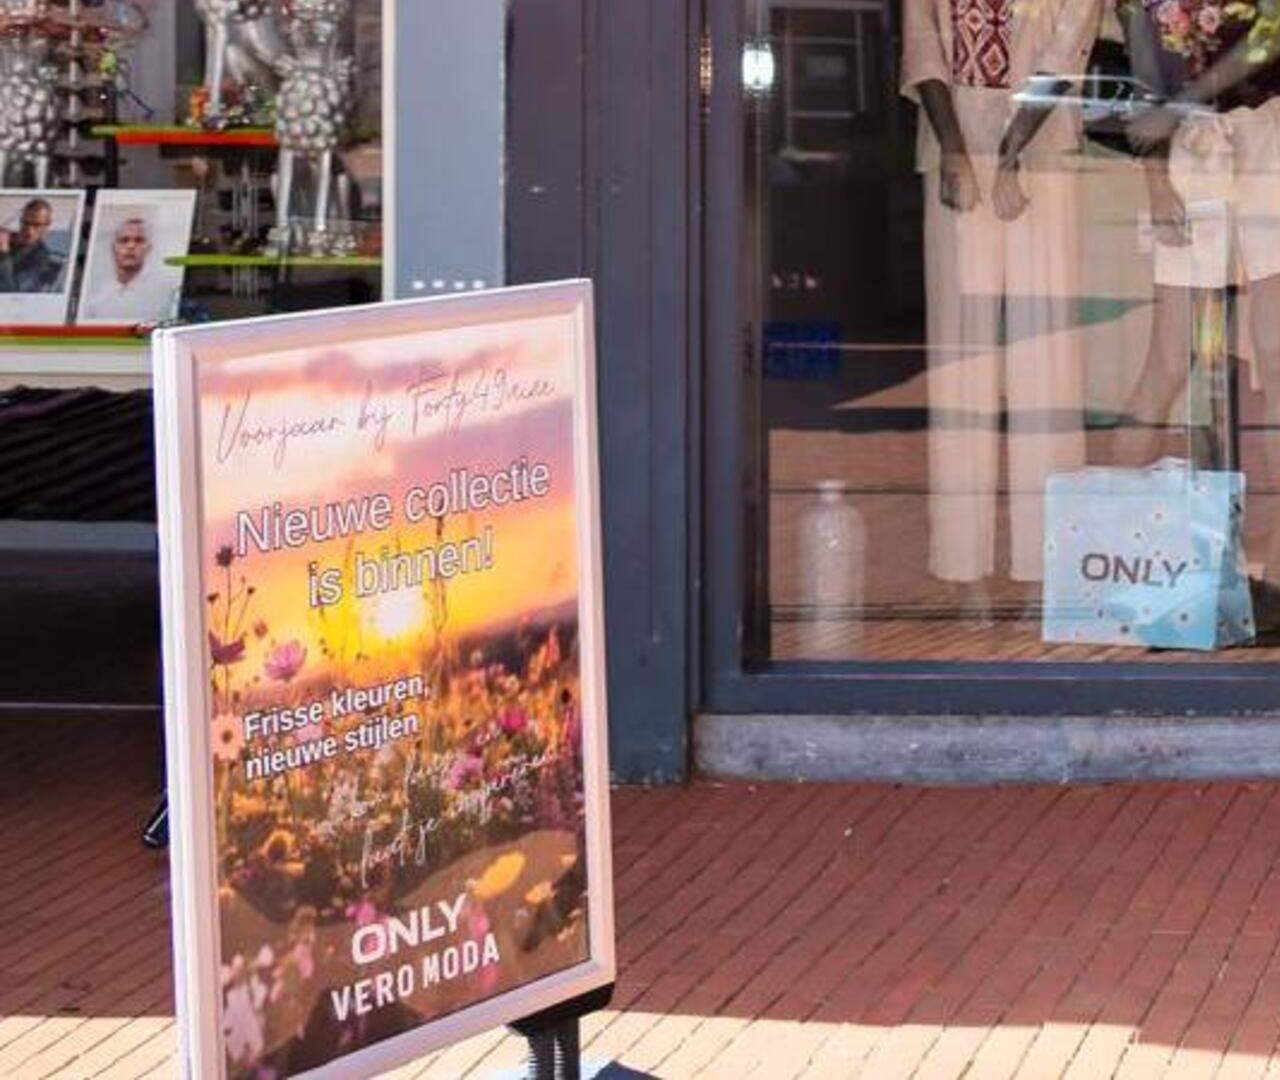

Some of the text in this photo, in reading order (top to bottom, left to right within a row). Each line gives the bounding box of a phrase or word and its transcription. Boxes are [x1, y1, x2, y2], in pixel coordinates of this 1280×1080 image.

[236, 456, 551, 558] Nieuwe collectie
[308, 524, 495, 608] is binnen!
[1082, 553, 1187, 588] ONLY
[244, 676, 430, 741] Frisse kleuren,
[246, 714, 418, 780] nieuwe stijlen
[352, 893, 467, 965] ONLY
[331, 933, 500, 1022] VERO MODA
